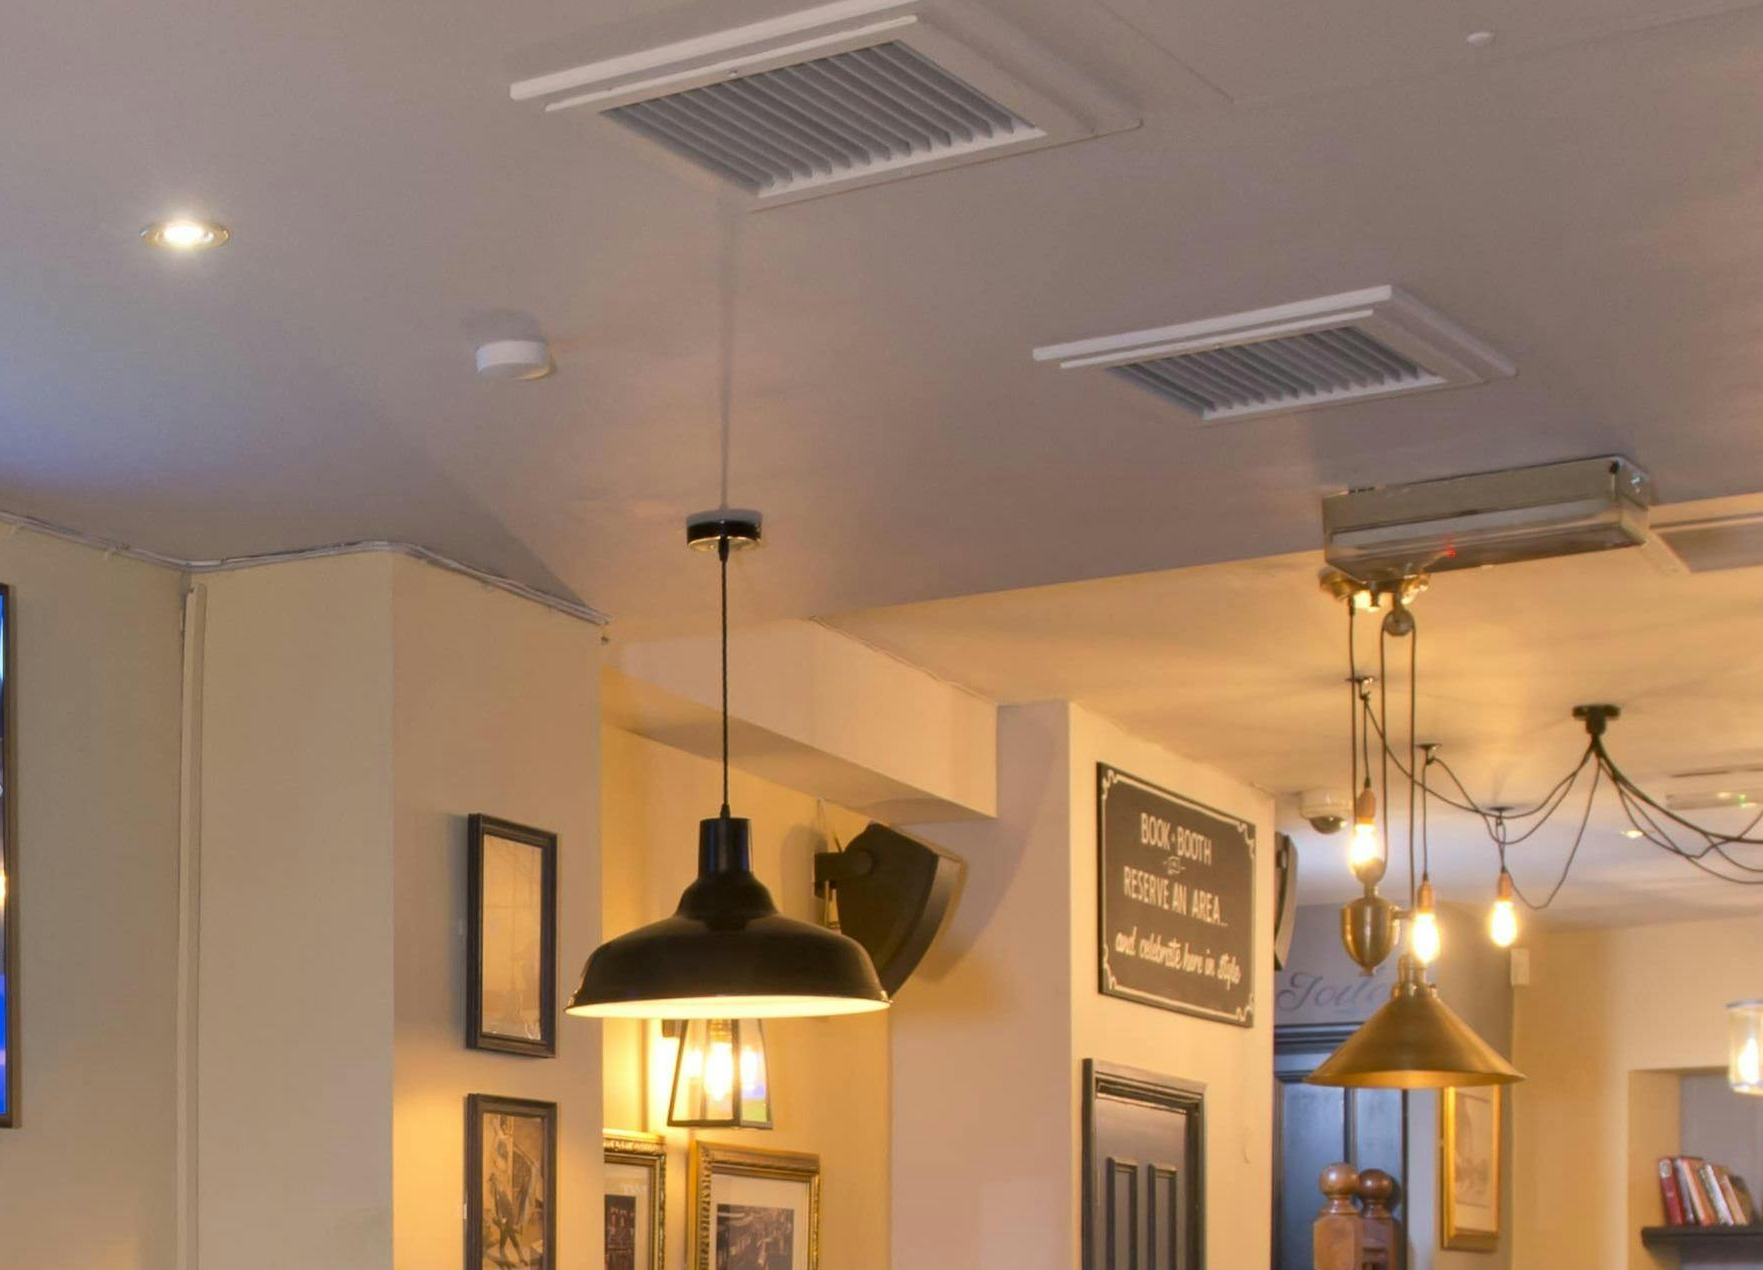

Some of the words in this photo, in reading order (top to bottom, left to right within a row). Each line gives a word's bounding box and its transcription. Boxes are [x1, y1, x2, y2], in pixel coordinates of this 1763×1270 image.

[1140, 812, 1171, 850] BOOK
[1177, 826, 1212, 866] BOOTH
[1124, 866, 1169, 910] RESERVE
[1172, 882, 1187, 915] AN
[1115, 926, 1137, 956] and
[1139, 933, 1181, 970] celebrate
[1183, 942, 1203, 974] here
[1204, 948, 1215, 977] in
[1217, 953, 1242, 991] style
